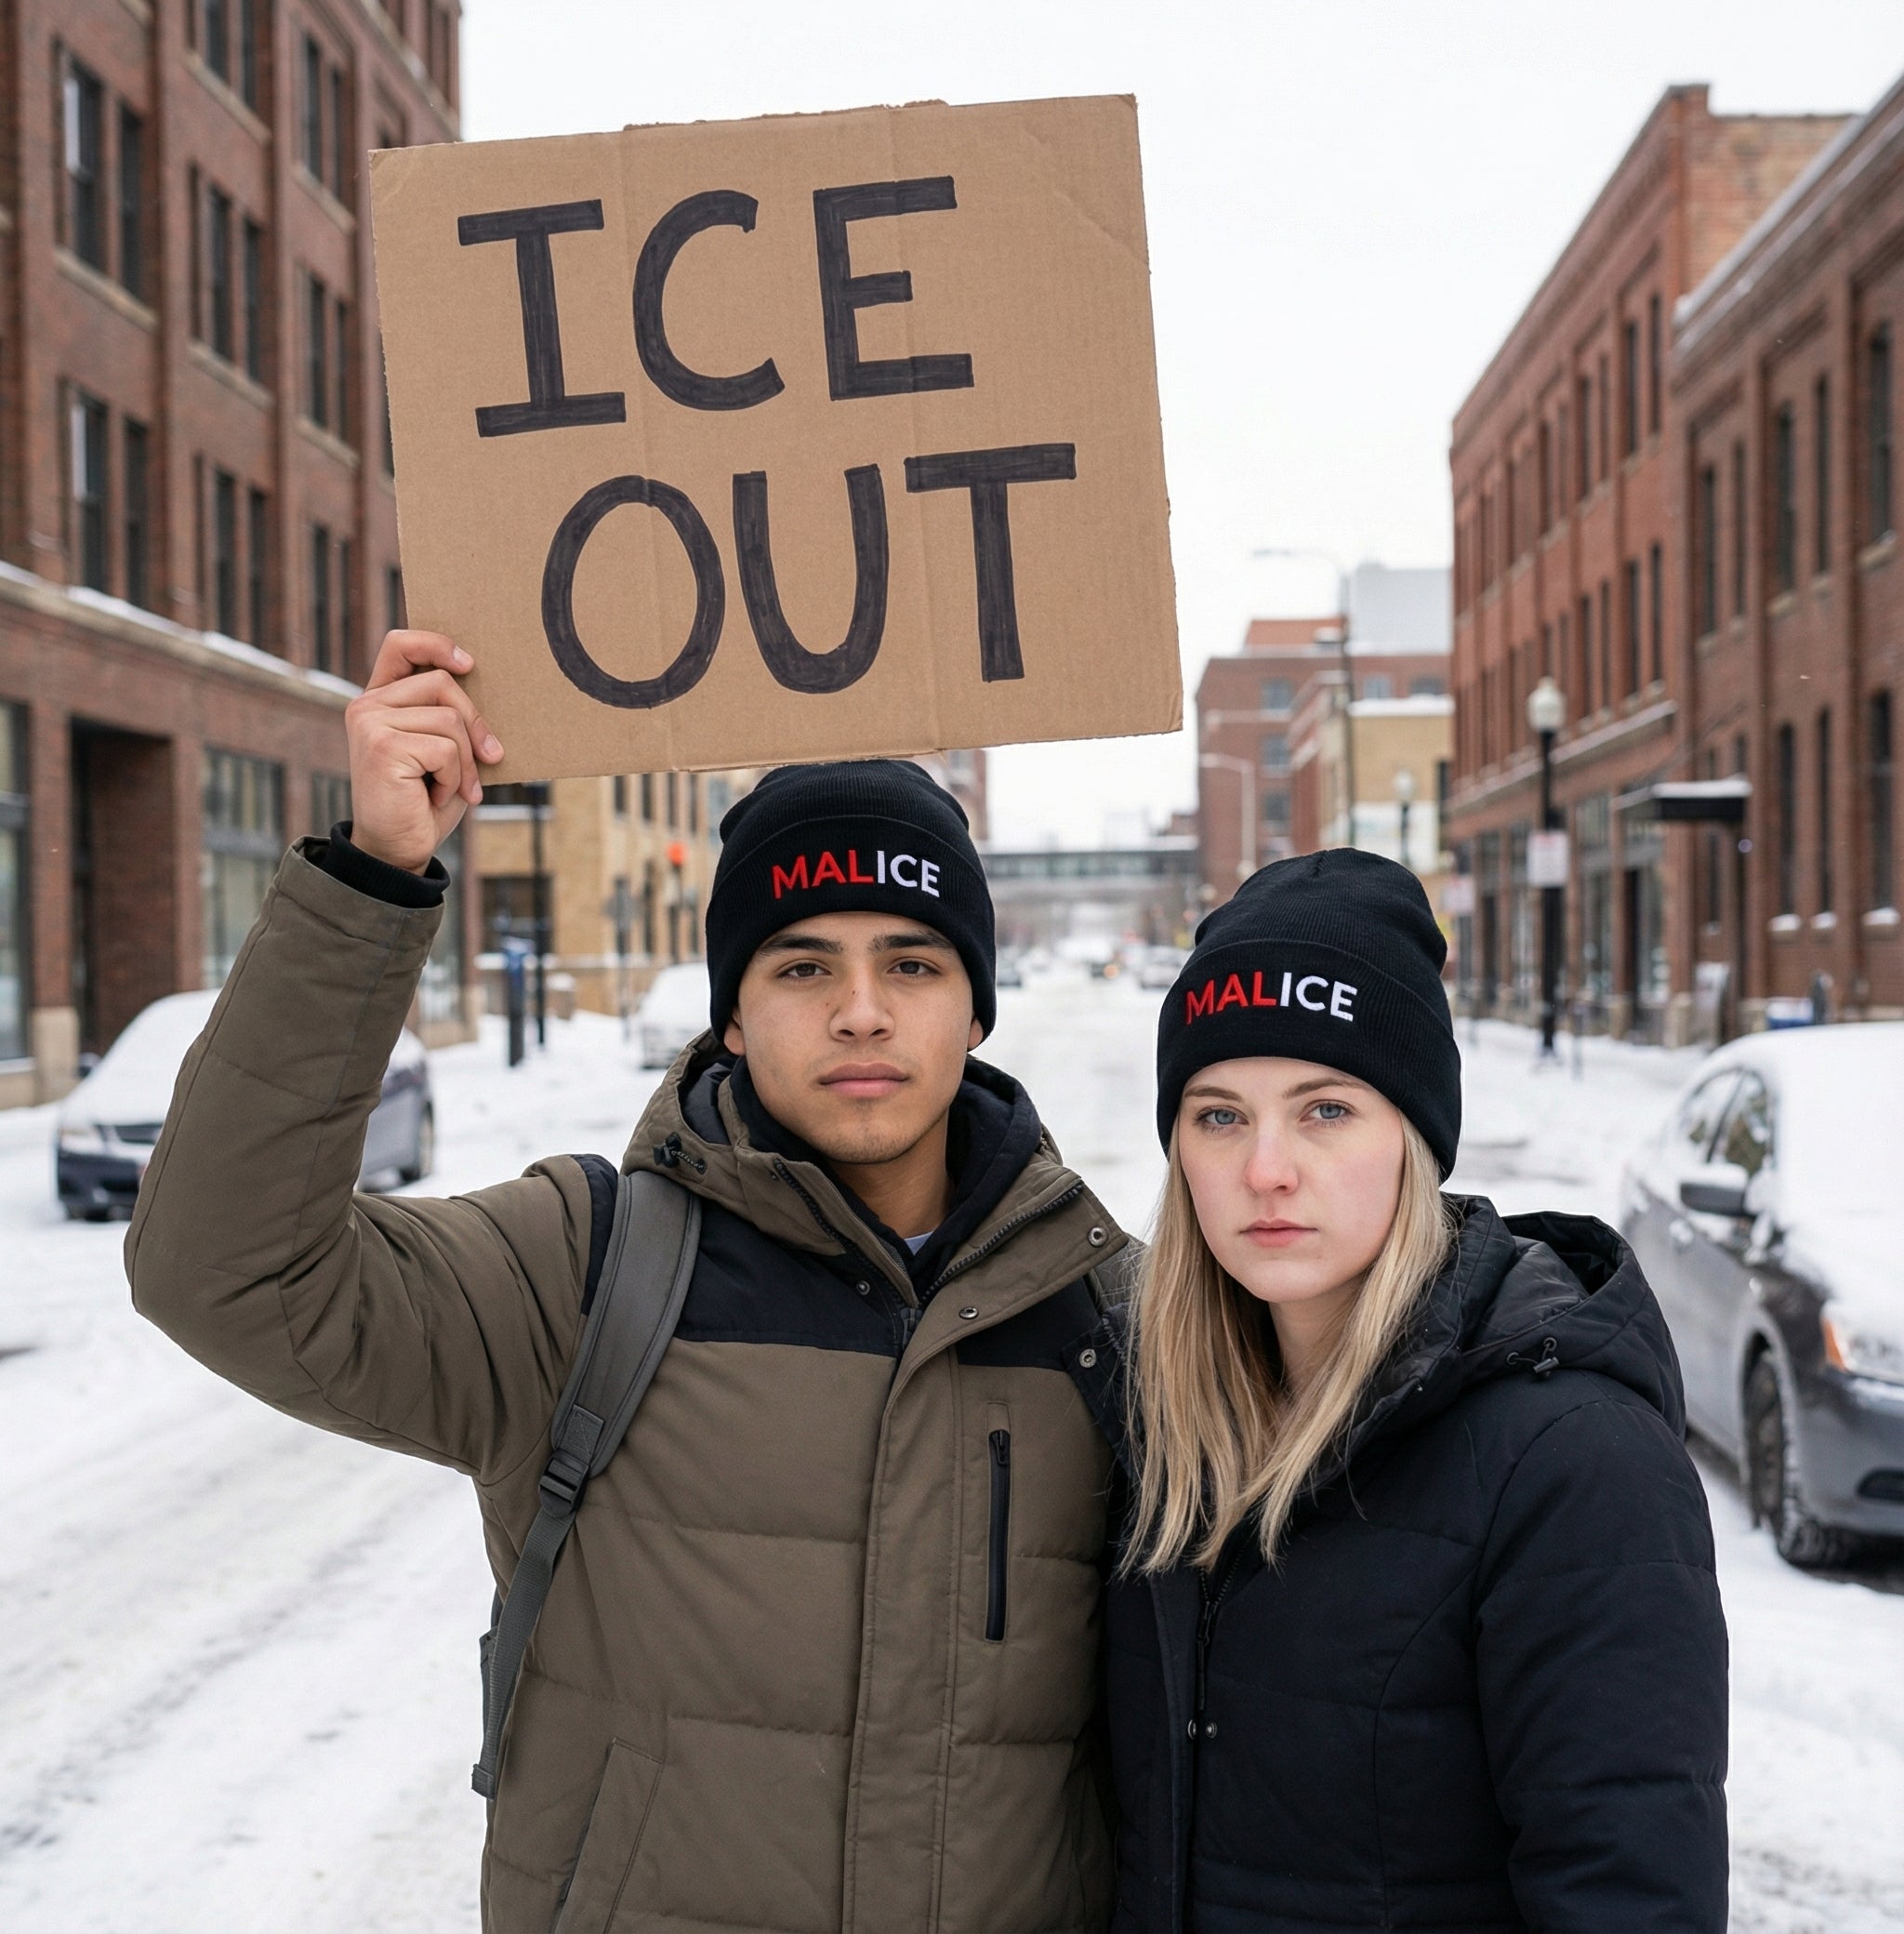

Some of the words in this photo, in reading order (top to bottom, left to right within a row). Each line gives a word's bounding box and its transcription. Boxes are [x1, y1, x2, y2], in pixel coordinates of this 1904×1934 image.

[456, 175, 975, 438] ICE
[541, 443, 1078, 709] OUT
[771, 849, 941, 900] MALICE
[1184, 971, 1359, 1026] MALICE
